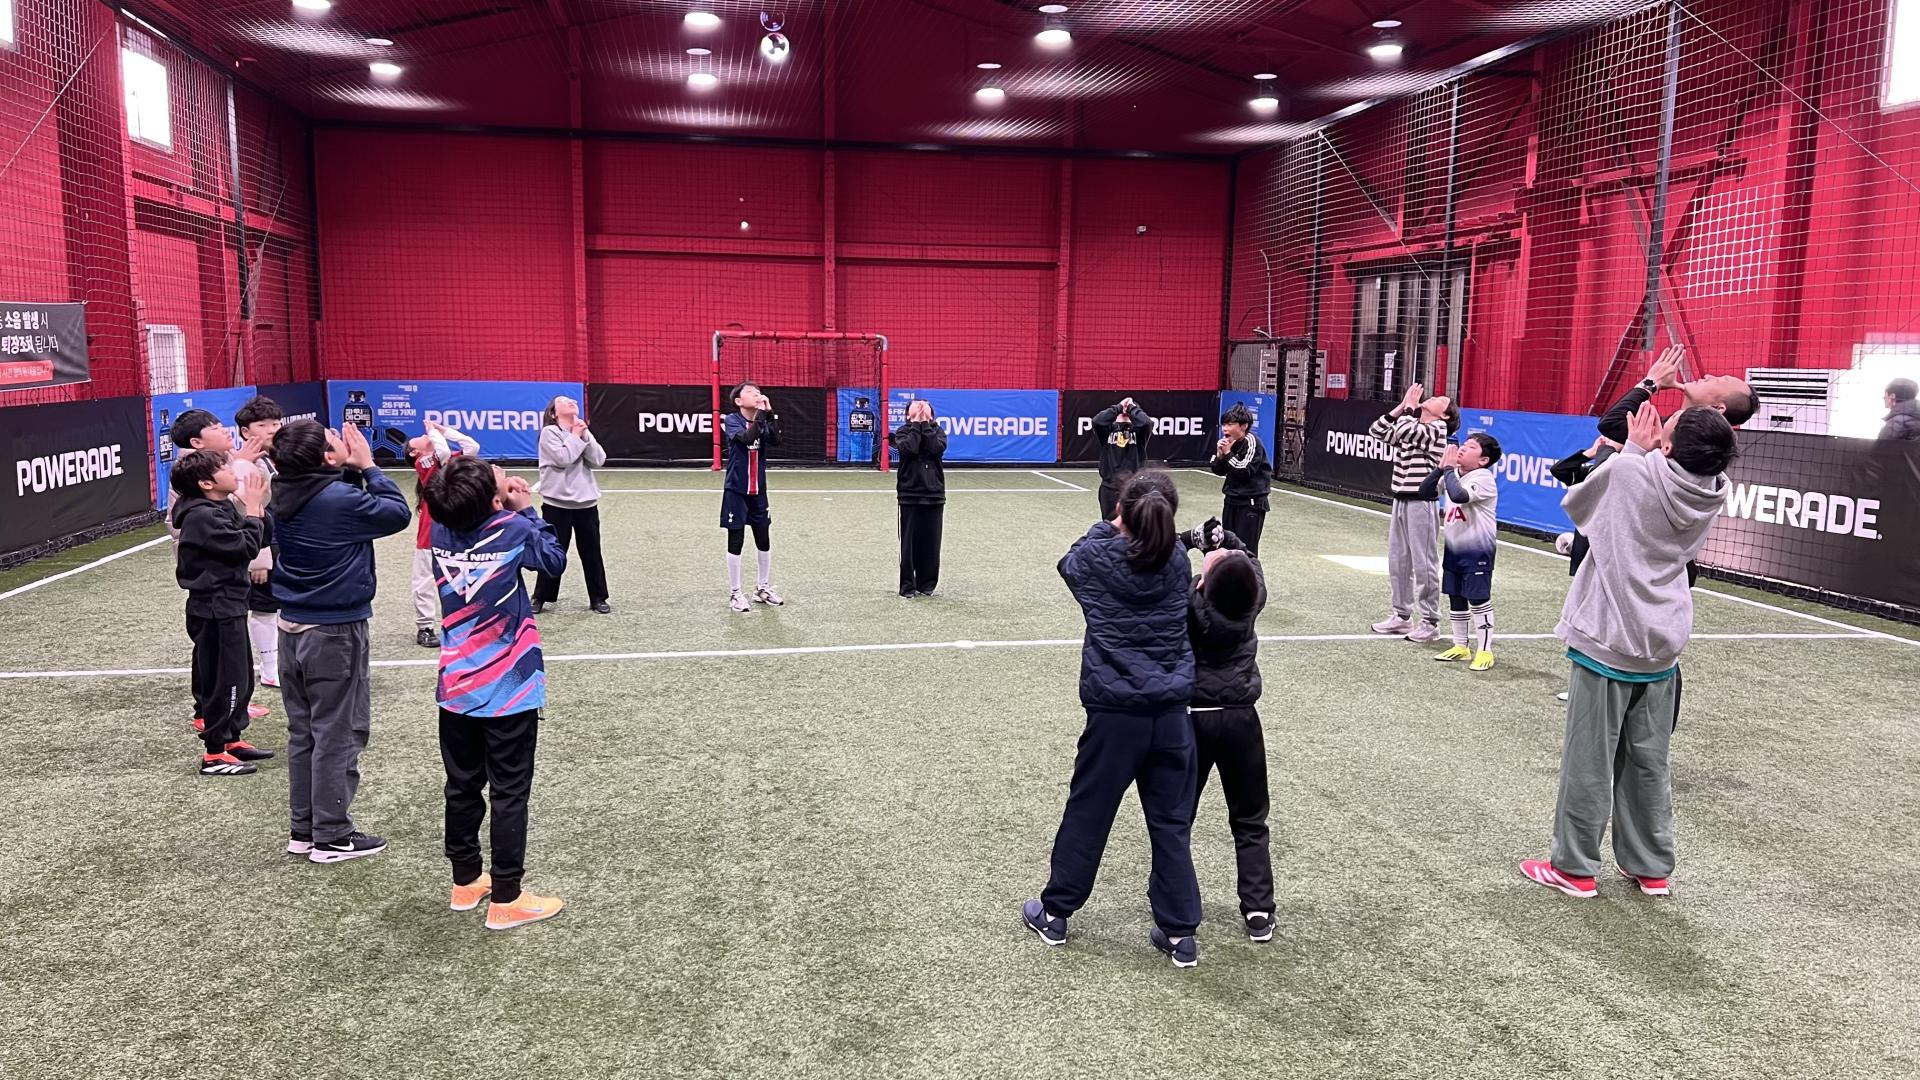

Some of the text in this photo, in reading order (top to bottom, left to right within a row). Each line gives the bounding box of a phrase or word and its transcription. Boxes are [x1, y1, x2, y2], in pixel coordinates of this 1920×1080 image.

[5, 311, 21, 329] 소음
[23, 311, 39, 329] 발생
[41, 311, 48, 329] 시
[35, 335, 59, 353] 됩니다
[424, 411, 544, 431] POWERA
[1077, 416, 1205, 436] PRADE
[16, 444, 124, 496] POWERADE
[1718, 483, 1883, 541] WERADE
[432, 546, 508, 561] PULSE NINE
